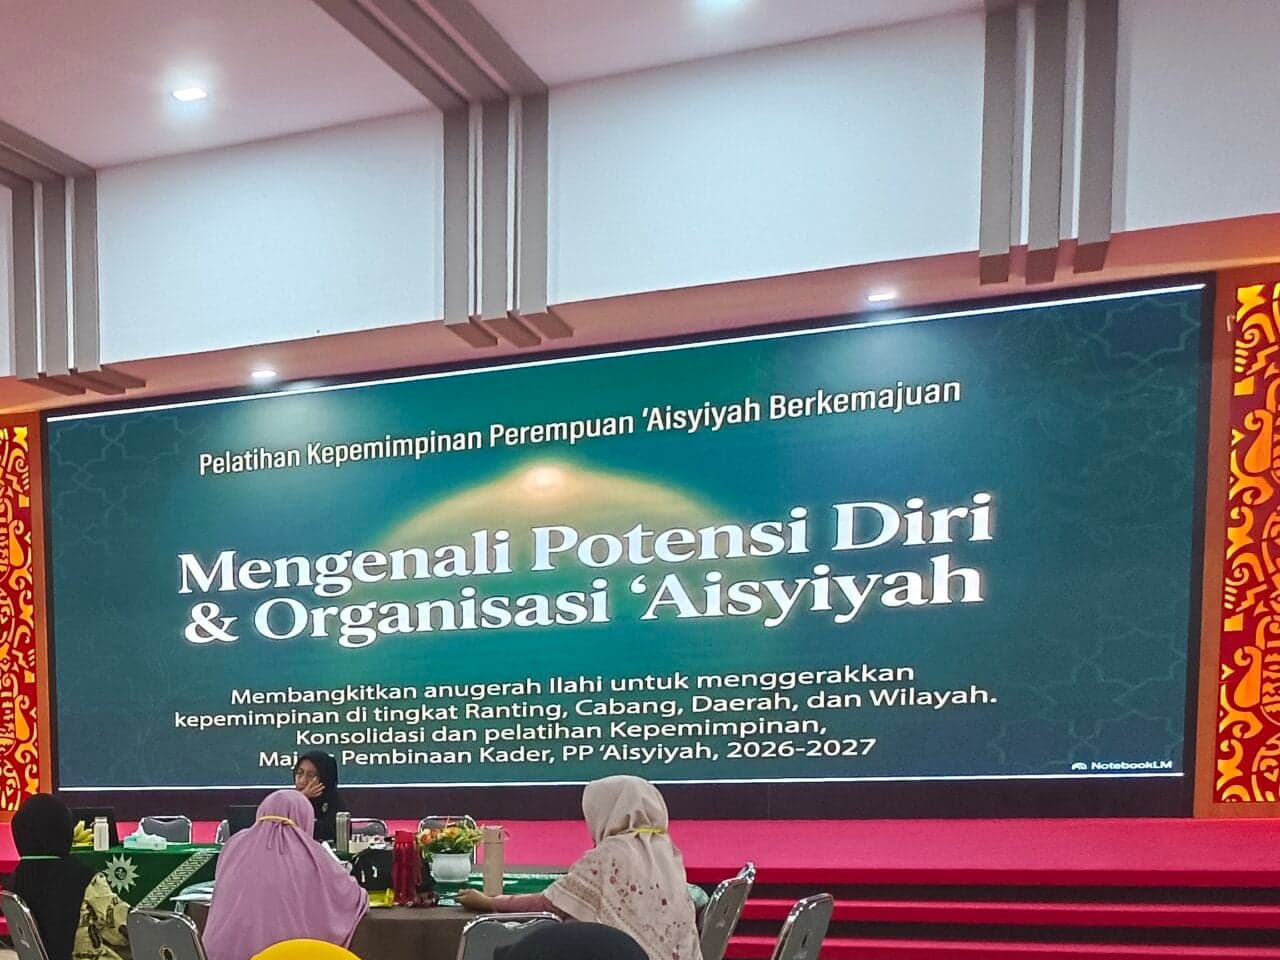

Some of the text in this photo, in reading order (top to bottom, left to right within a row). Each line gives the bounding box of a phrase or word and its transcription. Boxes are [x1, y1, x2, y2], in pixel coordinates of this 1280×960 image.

[199, 447, 302, 476] Pelatihan
[306, 429, 483, 468] Kepemimpinan
[490, 413, 635, 447] Perempuan
[769, 380, 962, 421] Berkemajuan
[177, 492, 994, 598] Mengenali Potensi Diri
[183, 602, 240, 645] &
[253, 579, 611, 649] Organisasi
[231, 664, 915, 706] Membangkitkan anugerah Ilahi untuk menggerakkan
[175, 685, 998, 731] kepemimpinan di tingkat Ranting, Cabang, Daerah, dan Wilayah.
[296, 717, 827, 747] Konsolidasi dan pelatihan Kepemimpinan,
[342, 747, 472, 767] Pembinaan
[479, 746, 554, 765] Kader,
[562, 745, 594, 761] PP
[726, 738, 877, 759] 2026-2027
[1091, 760, 1173, 770] NotebookLM
